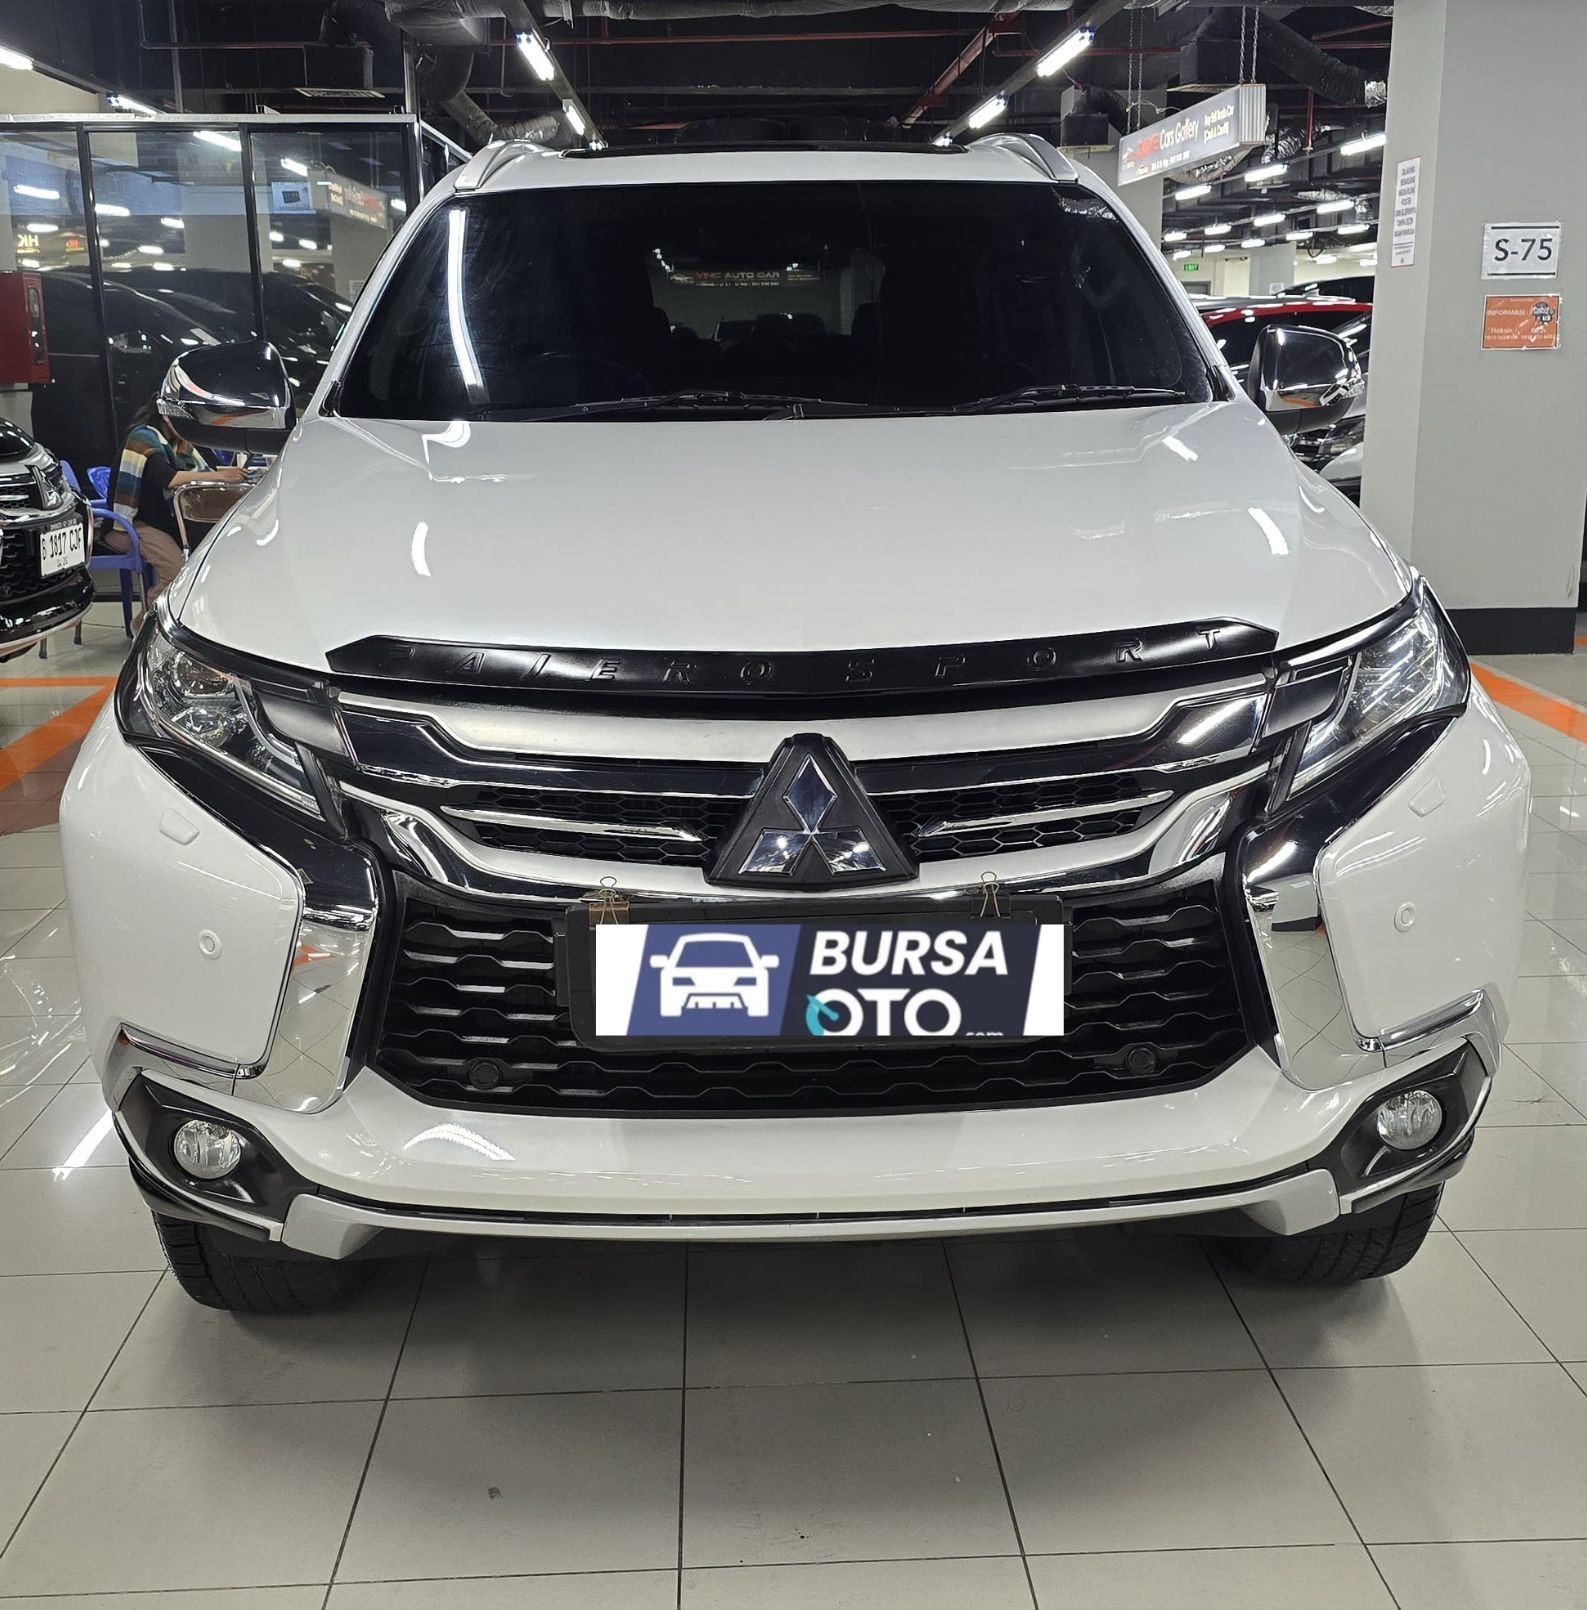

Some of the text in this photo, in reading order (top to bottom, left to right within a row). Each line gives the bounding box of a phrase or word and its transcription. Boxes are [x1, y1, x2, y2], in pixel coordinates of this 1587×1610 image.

[1160, 129, 1174, 149] Cars
[1175, 118, 1200, 142] Gallery
[1494, 237, 1553, 262] S-75
[724, 271, 754, 279] AUTO
[757, 271, 780, 279] CAR
[50, 532, 66, 559] 1817
[845, 627, 1221, 683] SPORT
